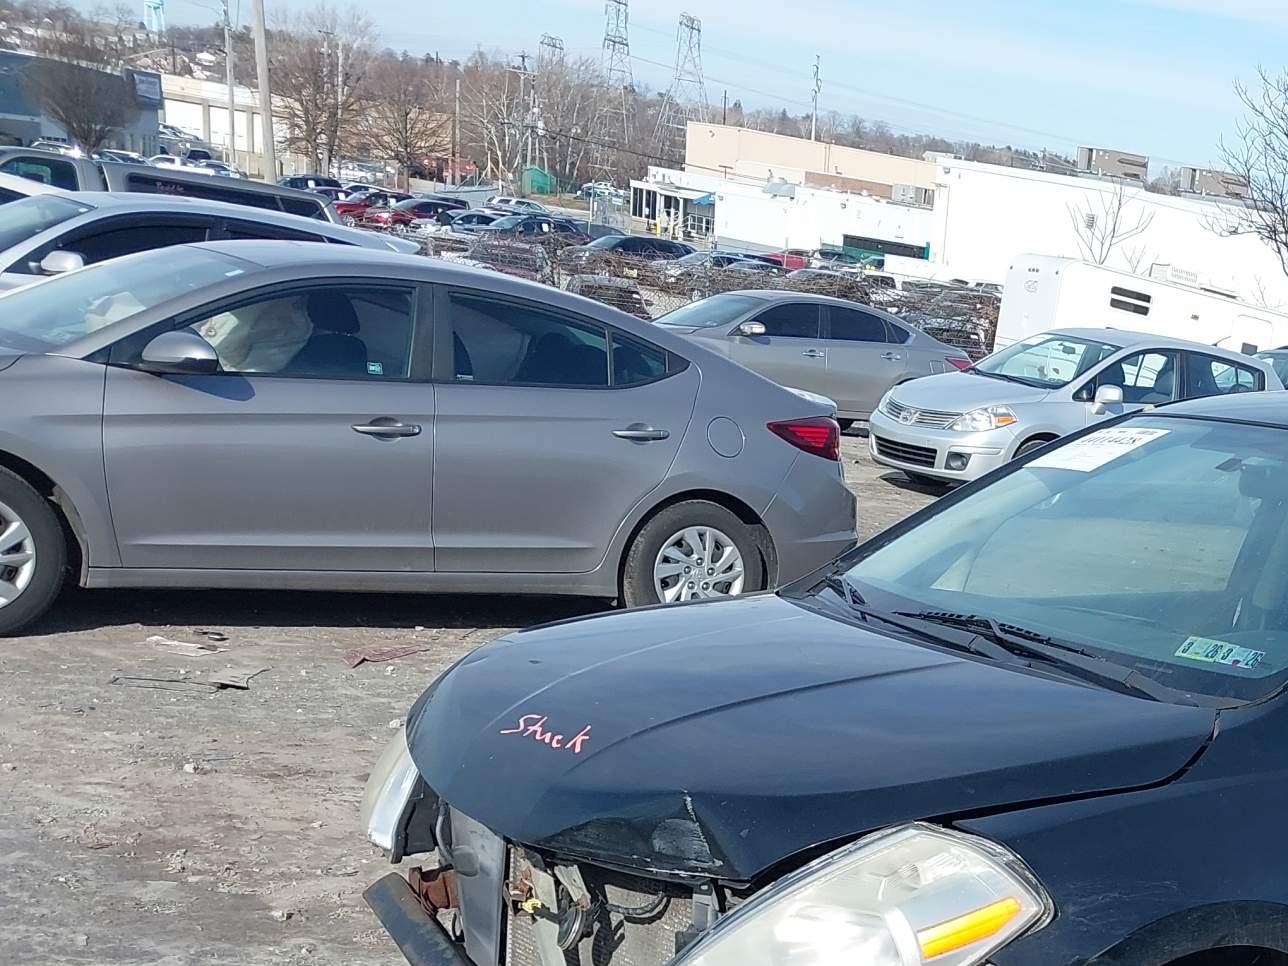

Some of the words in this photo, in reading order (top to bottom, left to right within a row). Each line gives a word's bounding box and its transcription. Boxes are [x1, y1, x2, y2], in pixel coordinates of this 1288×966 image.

[1182, 641, 1194, 654] 3
[1221, 648, 1233, 660] 3
[499, 713, 593, 753] Stuck
